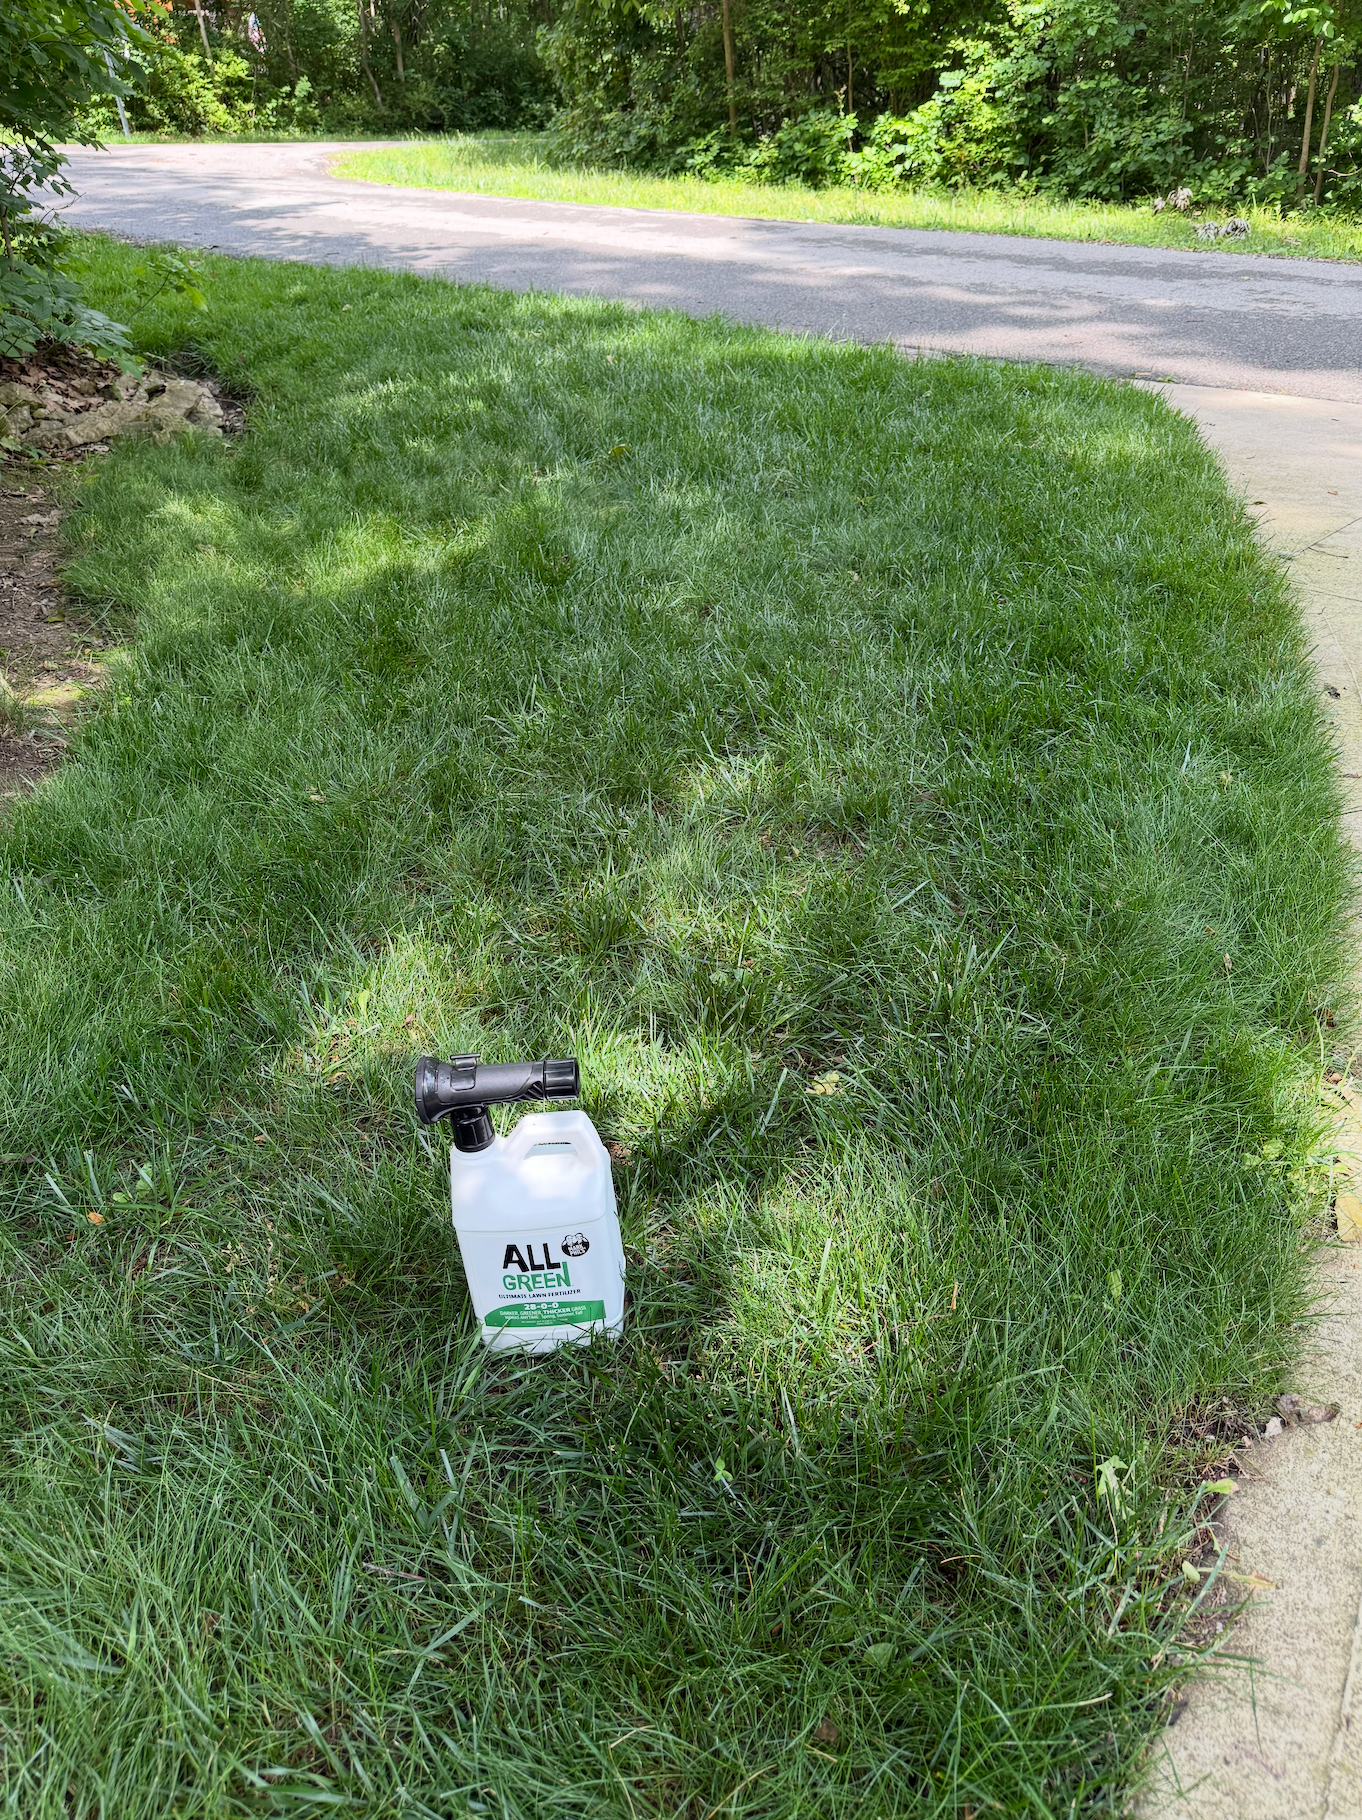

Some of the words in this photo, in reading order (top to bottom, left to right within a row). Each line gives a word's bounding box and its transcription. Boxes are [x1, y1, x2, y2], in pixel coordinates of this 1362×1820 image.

[503, 1243, 561, 1272] ALL
[503, 1261, 571, 1292] GREEN
[548, 1289, 581, 1297] FERTILIZER
[524, 1302, 560, 1310] 28-0-0
